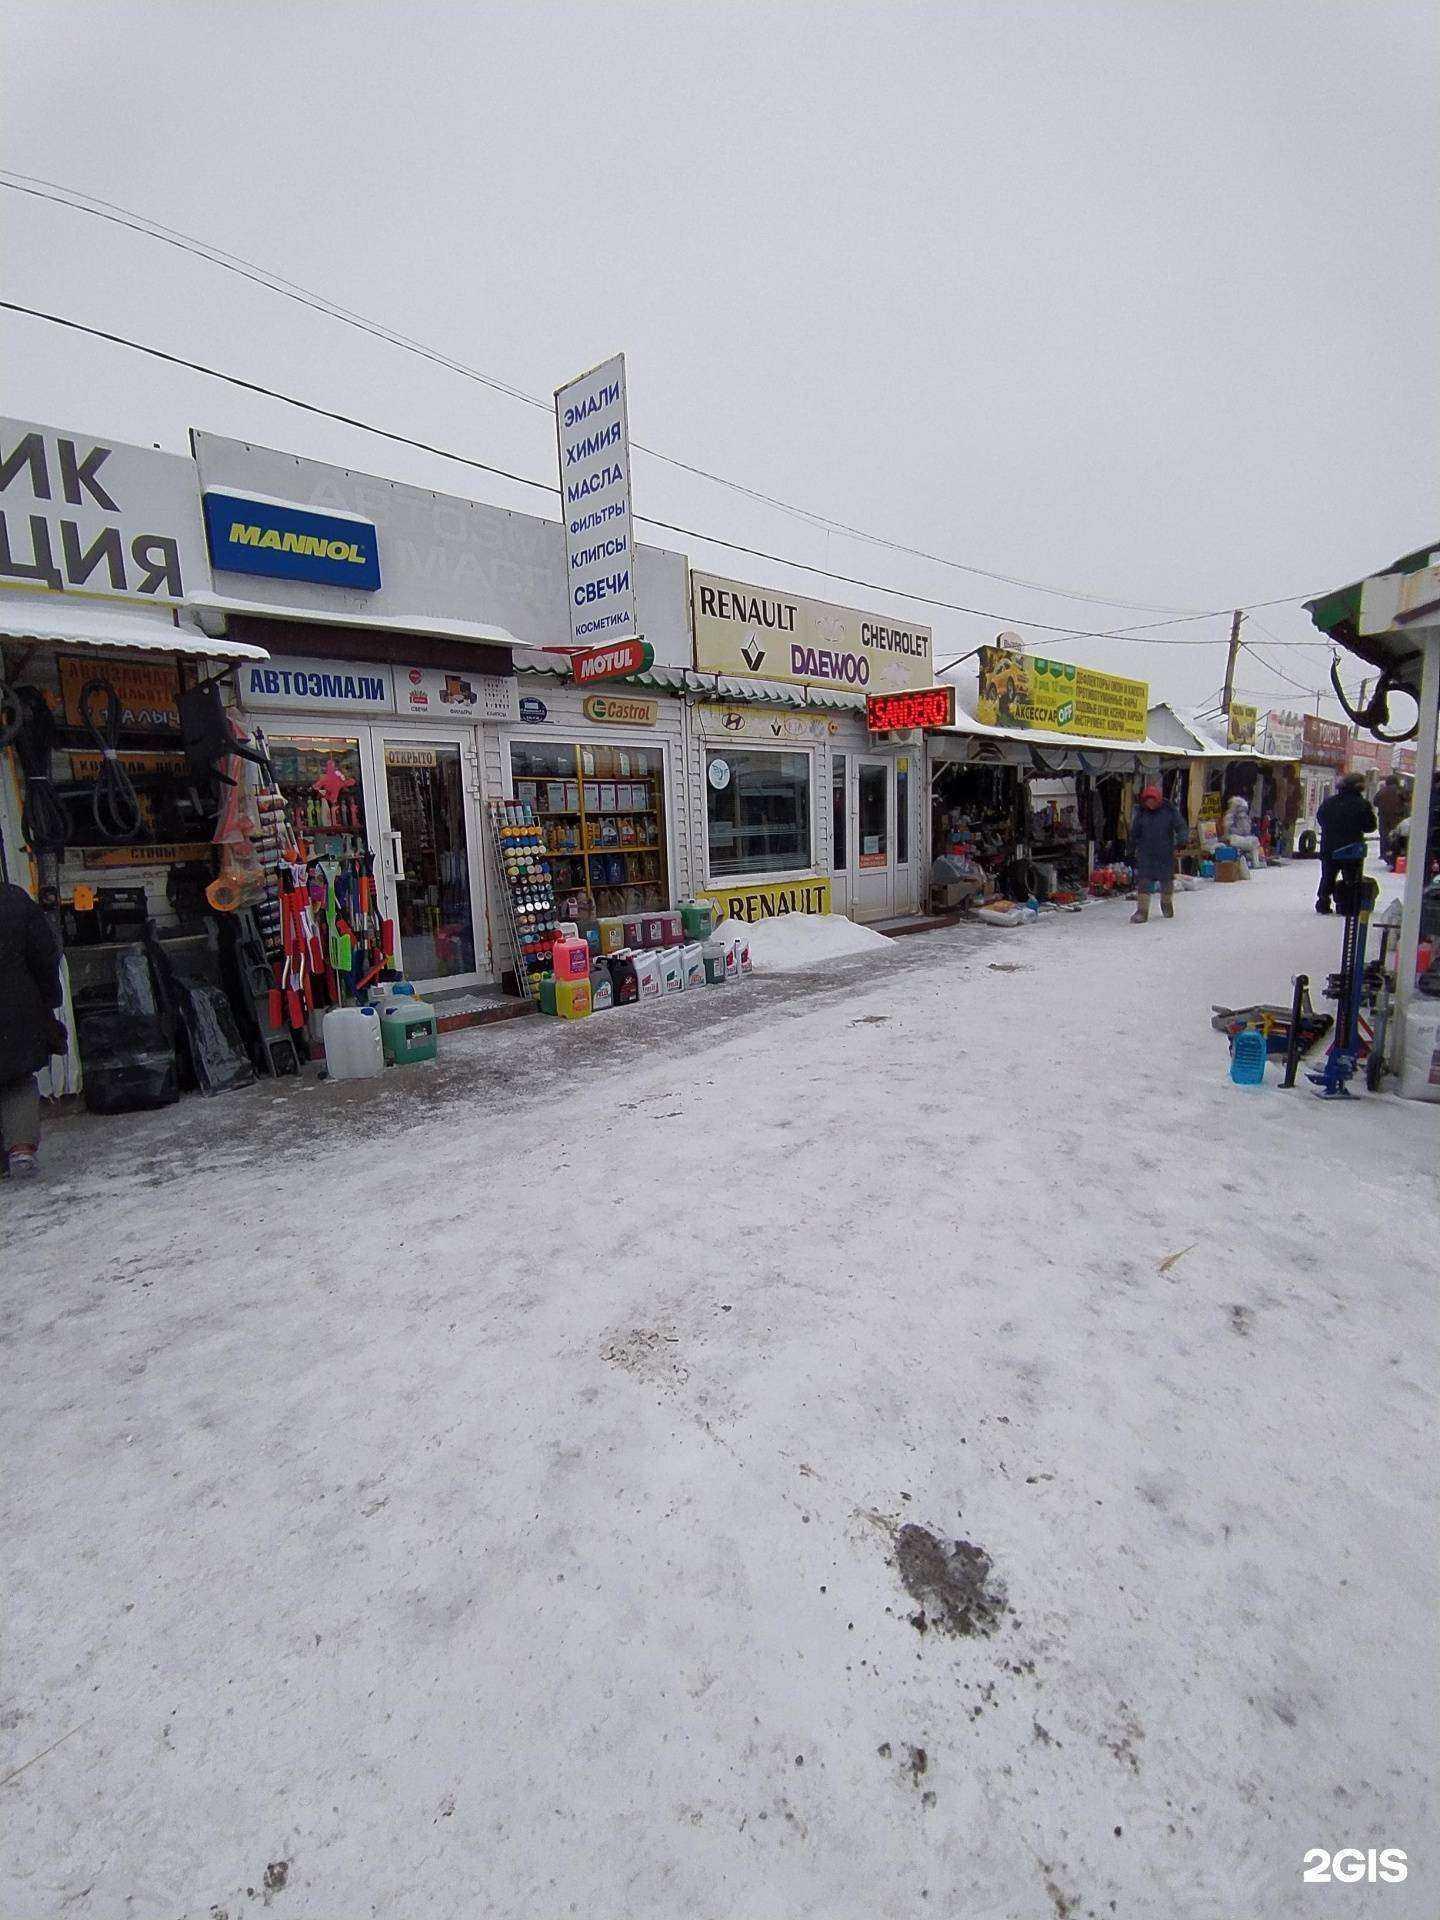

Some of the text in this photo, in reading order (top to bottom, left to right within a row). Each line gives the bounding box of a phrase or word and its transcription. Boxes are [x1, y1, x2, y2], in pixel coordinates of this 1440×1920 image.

[564, 381, 620, 428] ЭМАЛИ
[566, 421, 621, 467] ХИМИЯ
[567, 463, 623, 503] МАСЛА
[570, 500, 626, 535] ФИЛЬТРЫ
[229, 522, 366, 564] MANNOL
[571, 535, 627, 570] КЛИПСЫ
[573, 570, 629, 607] СВЕЧИ
[575, 612, 630, 636] КОСМЕТИКА
[700, 586, 797, 632] RENAULT
[861, 622, 929, 658] CHEVROLET
[581, 648, 633, 678] MOTUL
[791, 643, 870, 686] DAEWOO
[250, 668, 385, 700] АВТОЭМАЛИ
[608, 702, 650, 720] Castrol
[389, 751, 433, 765] ОТКРЫТО
[728, 886, 826, 924] RENAULT
